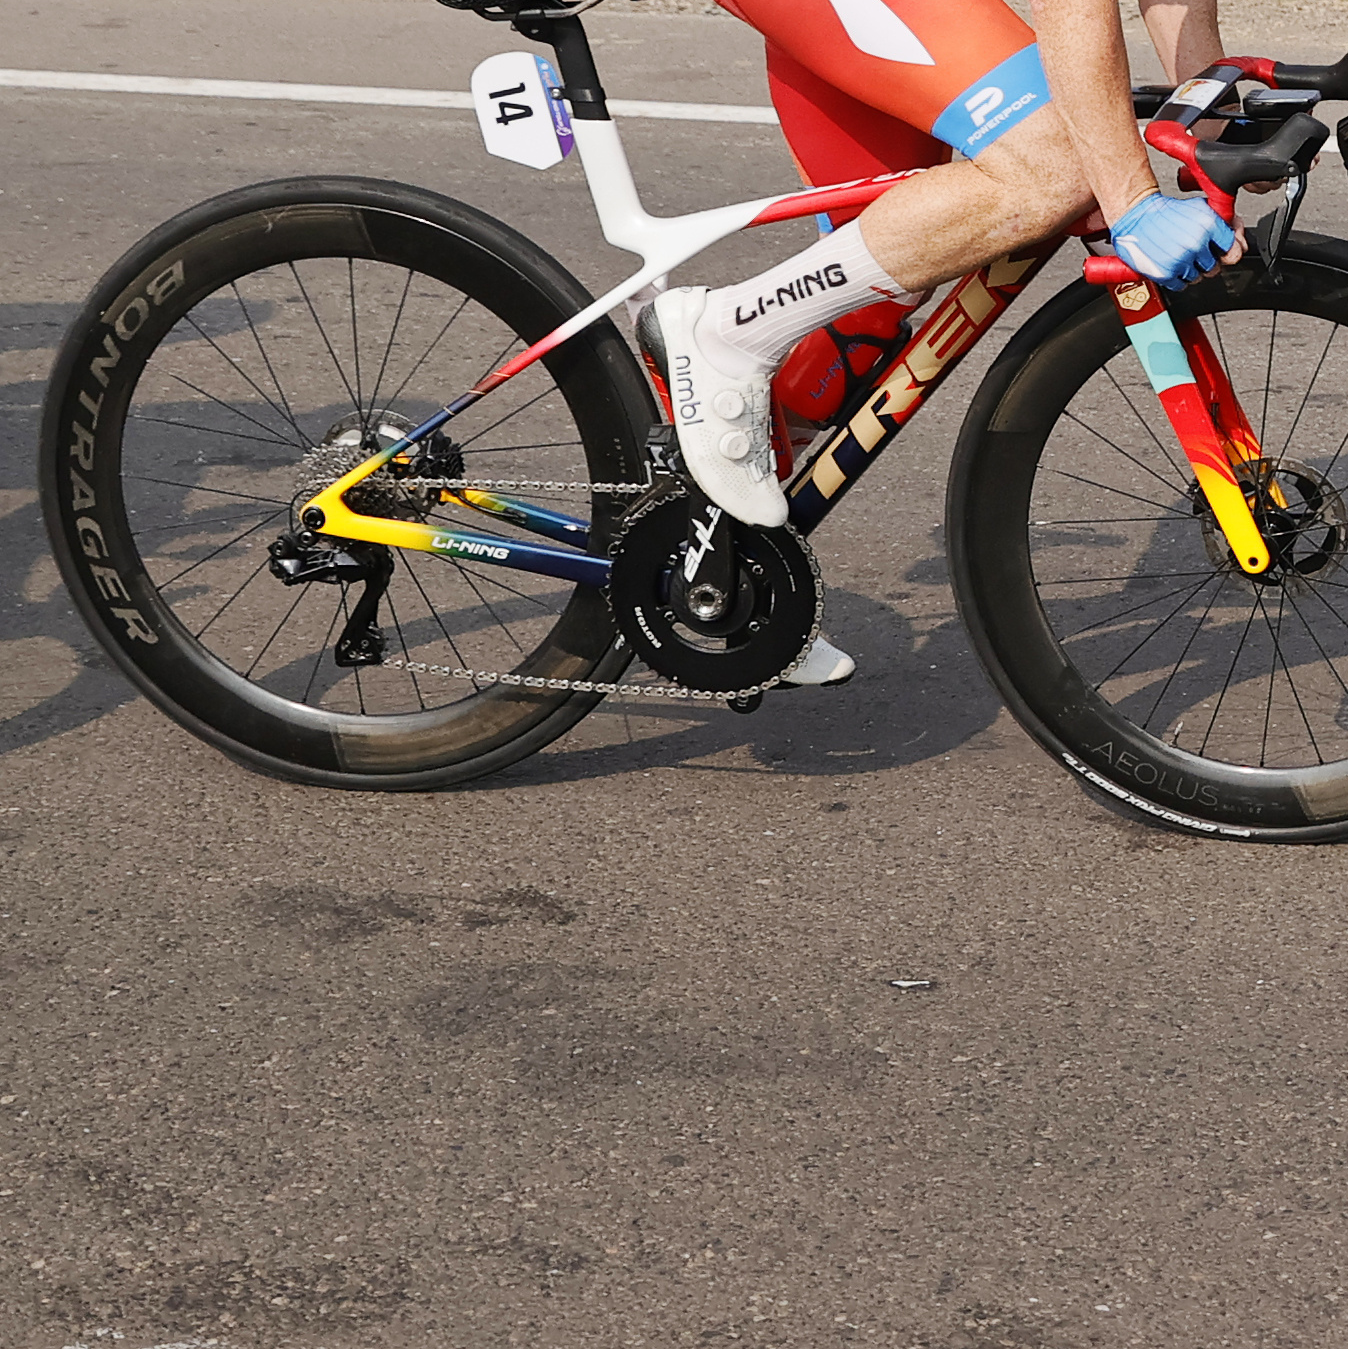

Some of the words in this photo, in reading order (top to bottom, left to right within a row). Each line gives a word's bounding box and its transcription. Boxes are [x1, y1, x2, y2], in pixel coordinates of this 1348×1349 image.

[489, 82, 533, 125] 14
[966, 92, 1037, 146] POWERPOOL
[735, 262, 849, 326] LI-NING
[675, 354, 705, 428] nimbl
[790, 252, 1040, 500] TREK
[69, 258, 185, 647] BONTRAGER
[430, 536, 509, 560] LI-NING
[1084, 773, 1128, 800] 5000
[1092, 742, 1219, 806] AEOLUS
[1125, 795, 1164, 818] PRIX
[1163, 811, 1218, 832] GRAND
